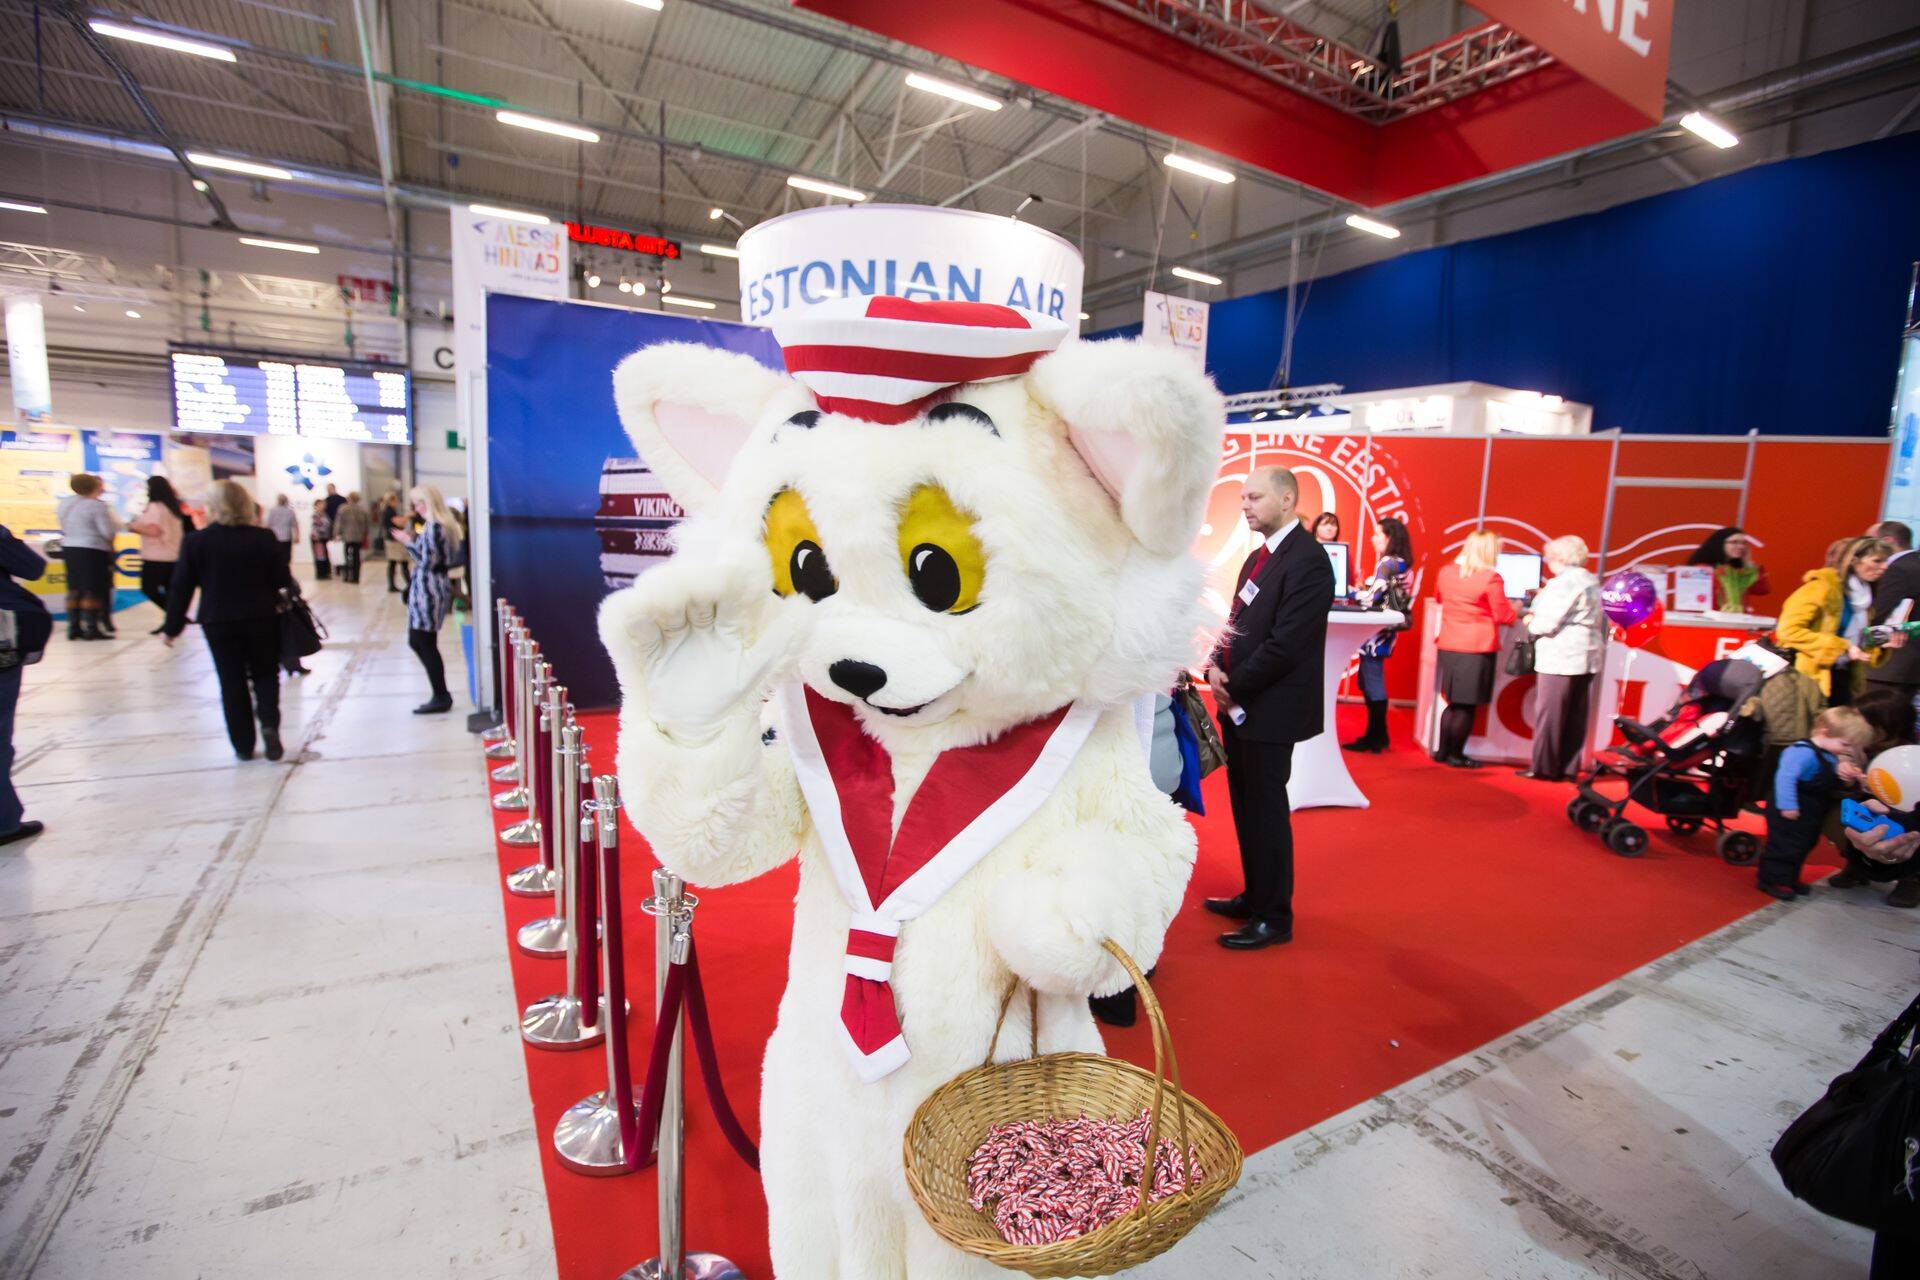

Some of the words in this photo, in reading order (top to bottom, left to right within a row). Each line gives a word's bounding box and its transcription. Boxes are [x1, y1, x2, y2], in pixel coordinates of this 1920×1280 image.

[749, 258, 983, 322] ESTONIAN
[1006, 275, 1065, 321] AIR
[633, 497, 681, 517] VIKING
